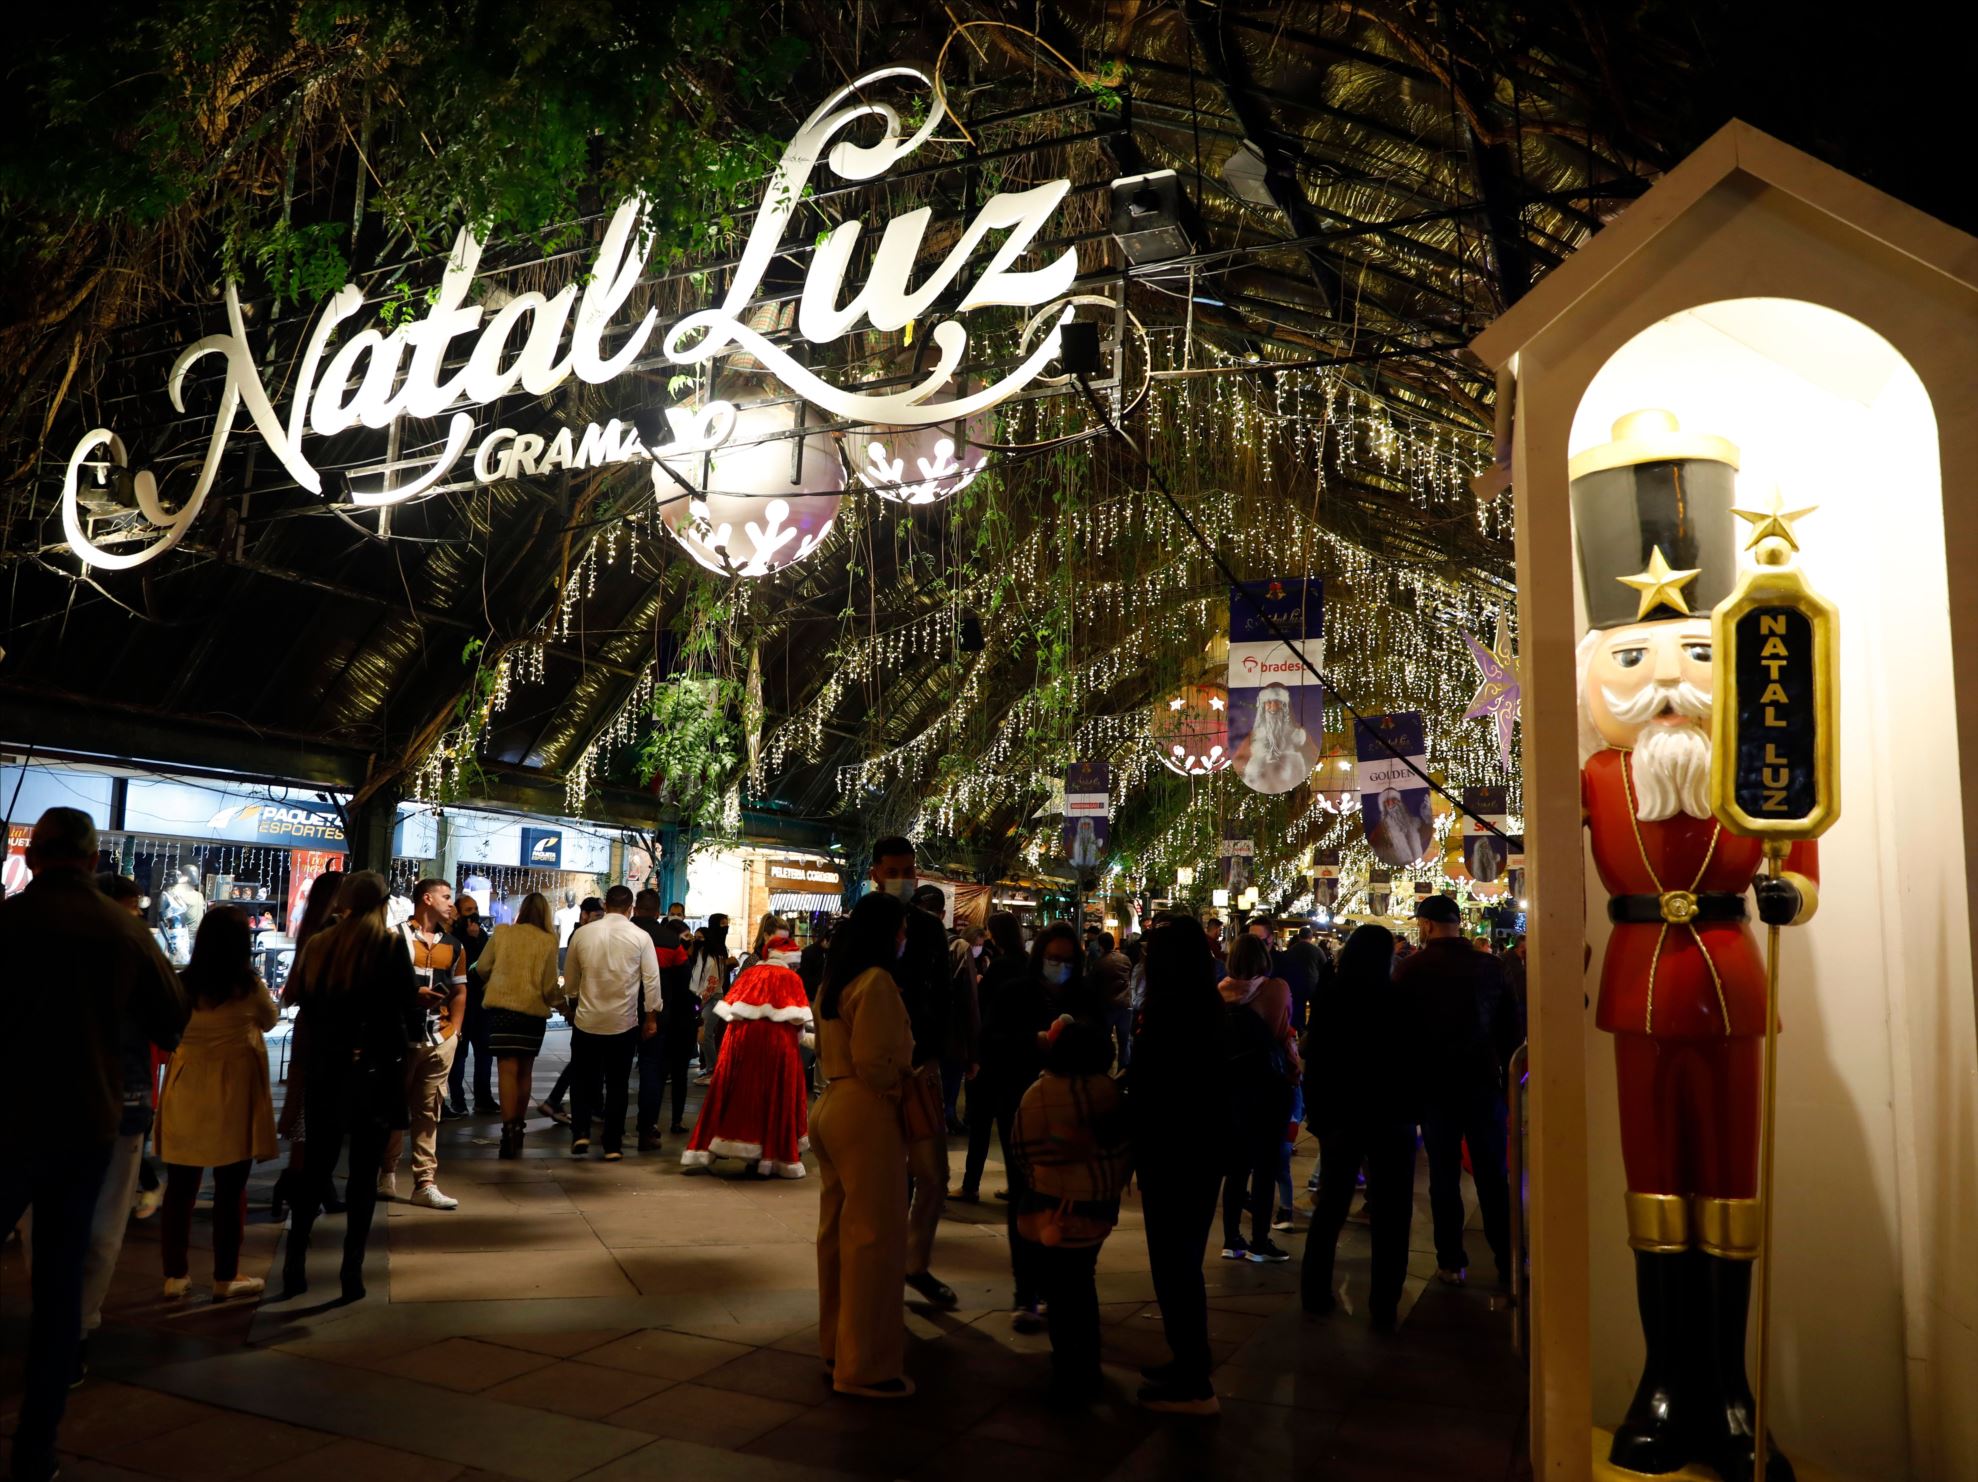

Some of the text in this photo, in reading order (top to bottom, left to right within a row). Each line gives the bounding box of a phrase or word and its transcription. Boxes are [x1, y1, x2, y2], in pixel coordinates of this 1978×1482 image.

[62, 66, 1078, 570] Natal Luz
[474, 400, 737, 482] GRAMAO
[1260, 660, 1314, 673] bradesc
[1760, 615, 1789, 811] NATAL LUZ
[1370, 769, 1416, 782] GOLDEN
[259, 821, 345, 840] ESPORTES
